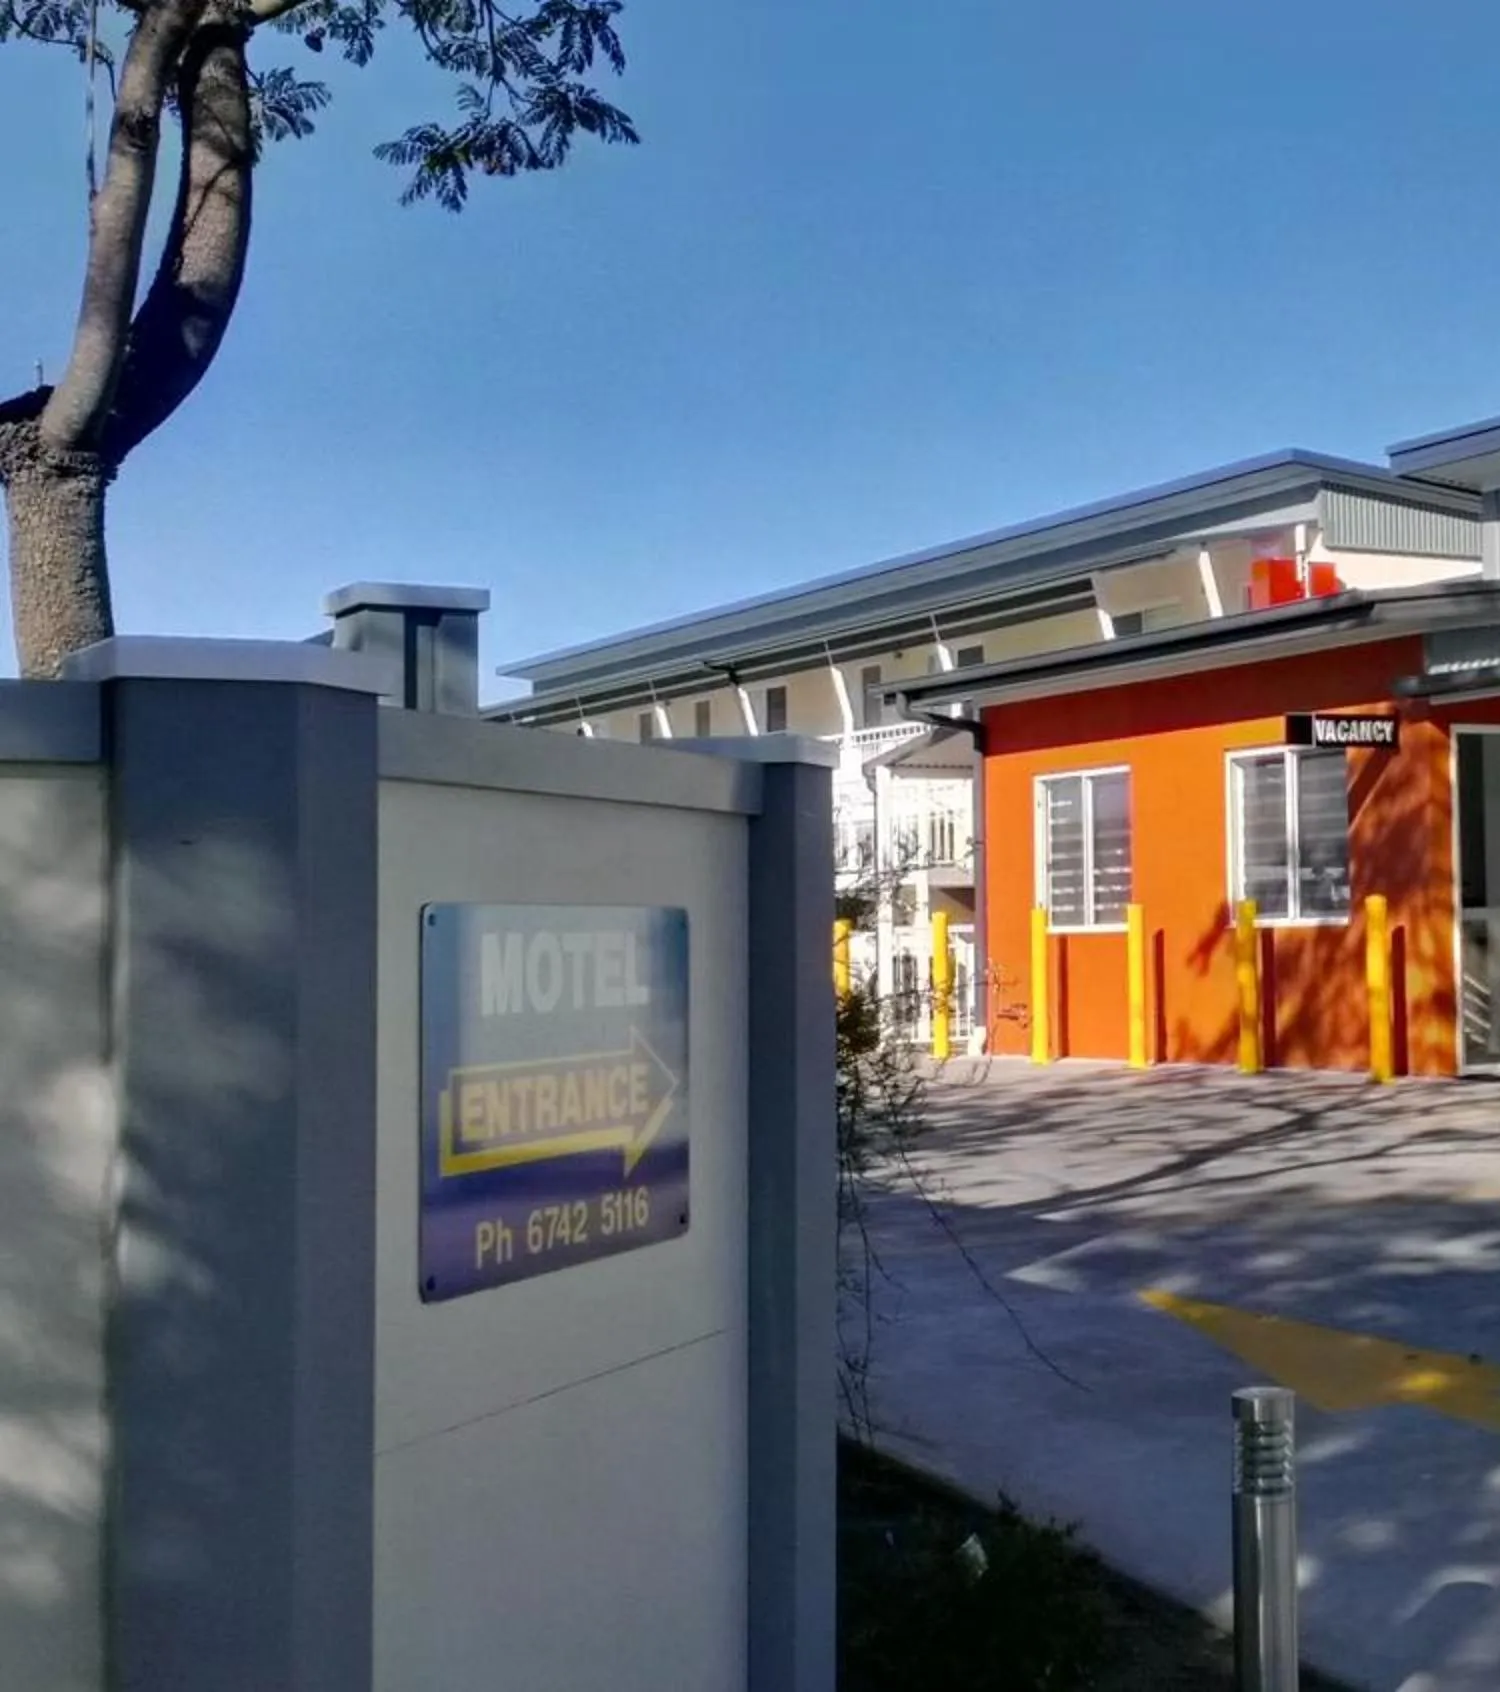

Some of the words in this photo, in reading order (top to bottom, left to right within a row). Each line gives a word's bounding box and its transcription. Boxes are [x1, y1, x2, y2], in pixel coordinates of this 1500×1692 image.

[1315, 719, 1394, 742] VACANCY
[481, 931, 649, 1016] MOTEL
[461, 1063, 649, 1142] ENTRANCE
[475, 1218, 513, 1269] Ph
[528, 1202, 588, 1254] 6742
[602, 1187, 649, 1236] 5116
